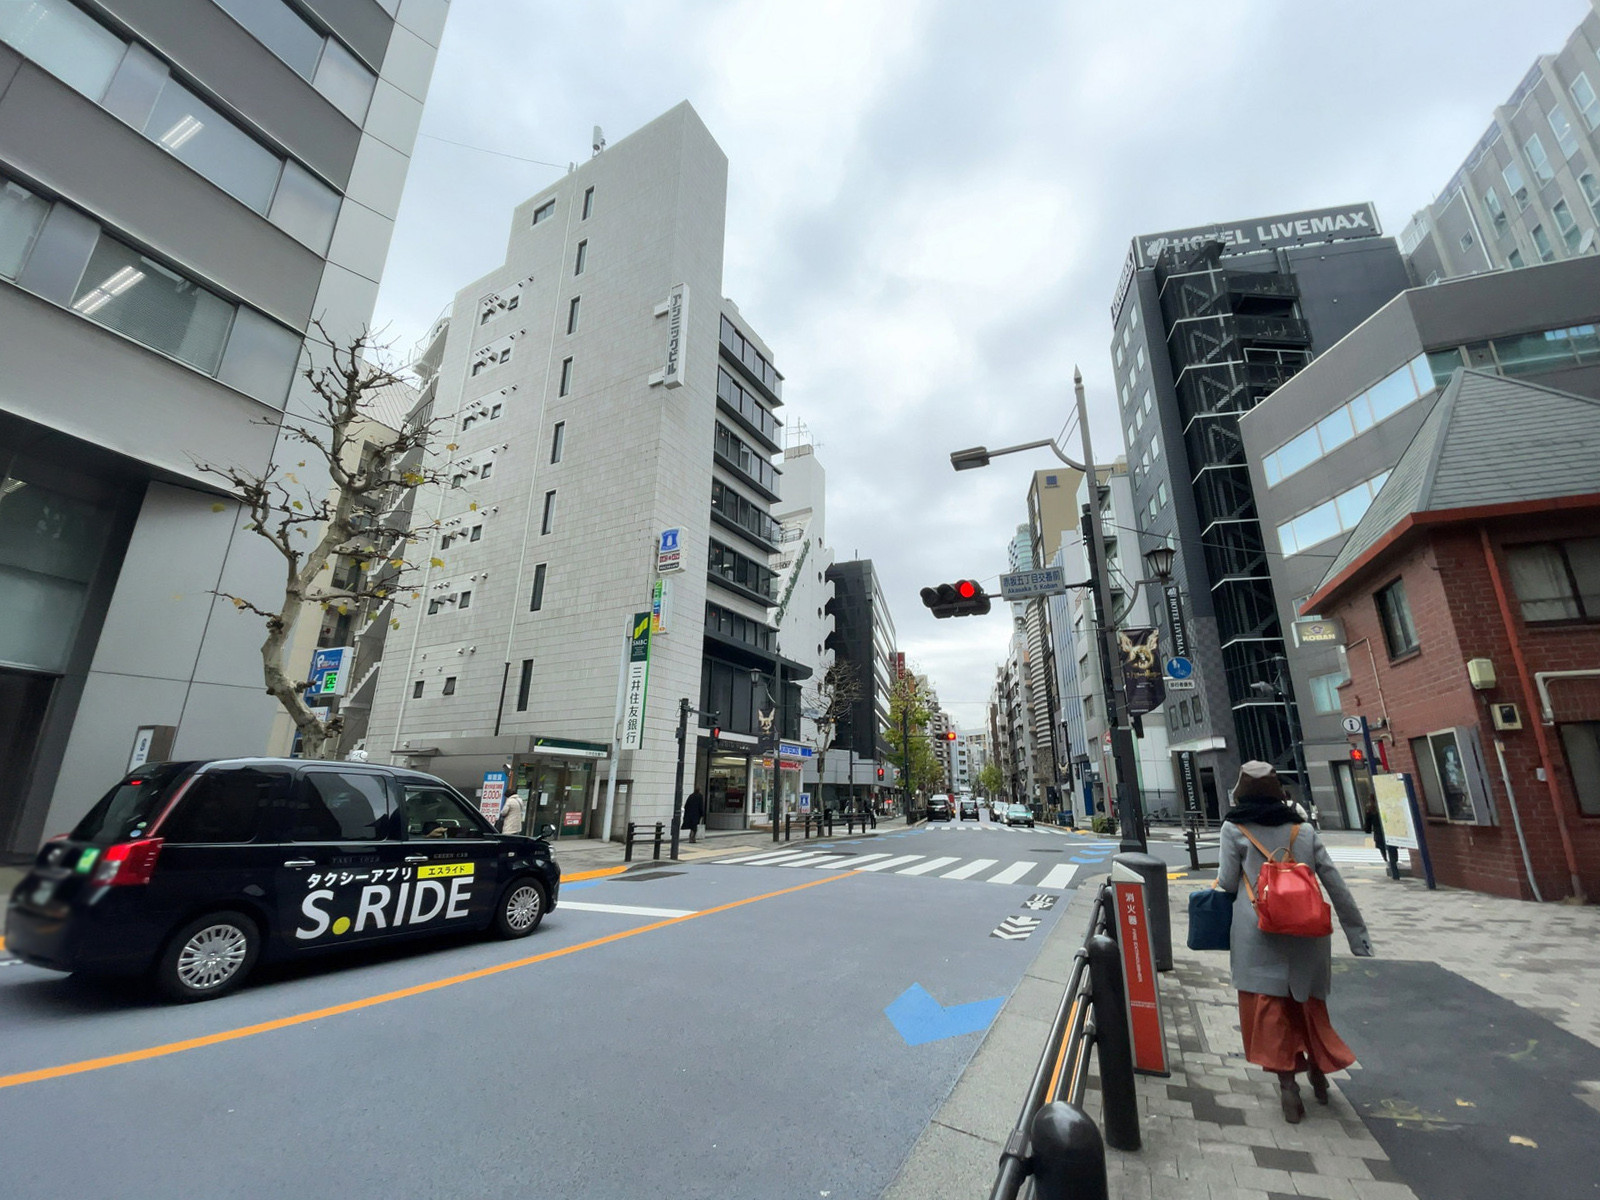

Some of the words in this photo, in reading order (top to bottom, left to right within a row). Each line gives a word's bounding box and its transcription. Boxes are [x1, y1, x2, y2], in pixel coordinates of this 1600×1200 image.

[1256, 211, 1369, 241] LIVEMAX
[1003, 570, 1060, 587] 赤坂五丁目交番前
[1007, 585, 1032, 594] Akasaka
[1039, 582, 1058, 590] Koban
[1170, 598, 1180, 621] HOTEL
[1174, 623, 1186, 656] LIVEMAX
[1302, 634, 1336, 642] KOBAN
[626, 666, 642, 744] 三井住友銀行
[1183, 760, 1192, 780] HOTEL
[307, 867, 412, 889] タクシーアプリ
[428, 866, 465, 876] エスライド
[295, 876, 475, 940] S.RIDE
[1125, 893, 1138, 925] 消火器
